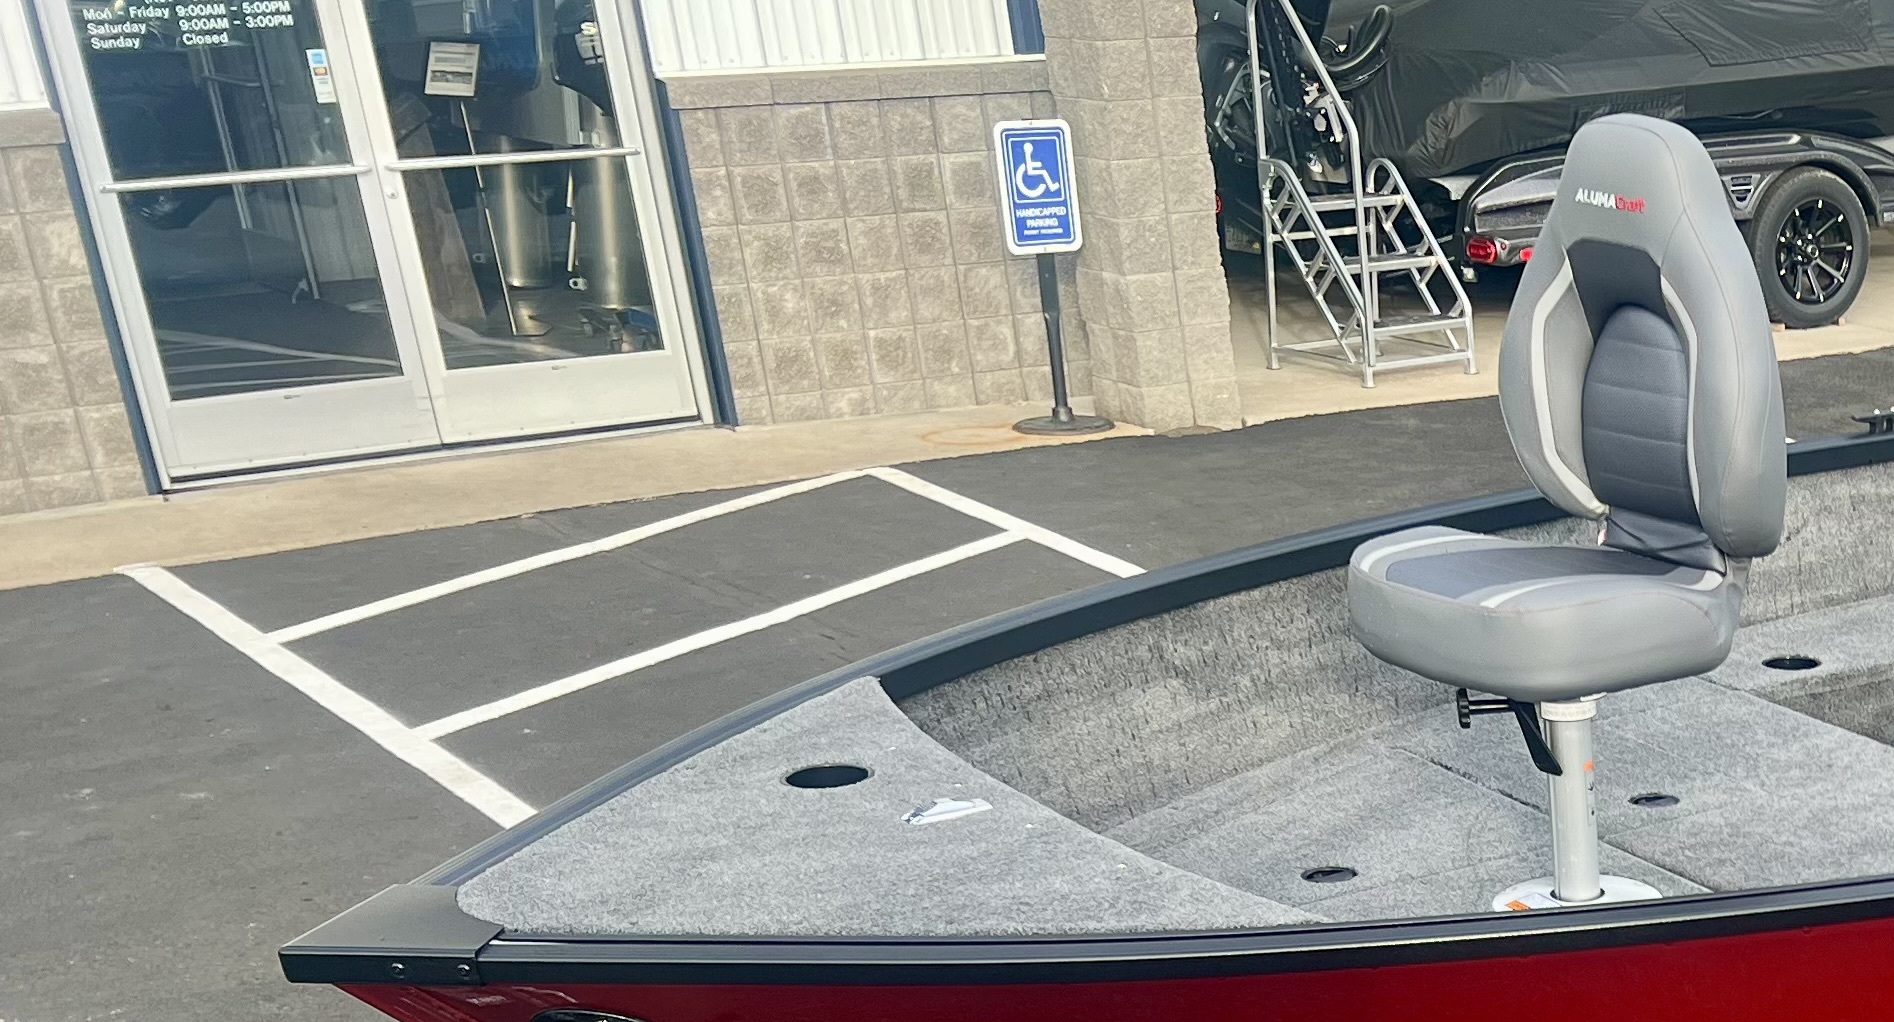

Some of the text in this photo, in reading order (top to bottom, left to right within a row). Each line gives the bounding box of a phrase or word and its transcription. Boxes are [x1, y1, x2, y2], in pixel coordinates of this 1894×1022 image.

[82, 8, 113, 20] Mon
[129, 6, 170, 19] Friday
[175, 4, 226, 17] 9:00AM
[242, 1, 291, 14] 5:00PM
[87, 21, 147, 35] Saturday
[179, 18, 230, 31] 9:00AM
[245, 14, 294, 28] 3:00PM
[90, 32, 229, 49] Sunday Closed
[1016, 206, 1067, 218] HANDICAPPED
